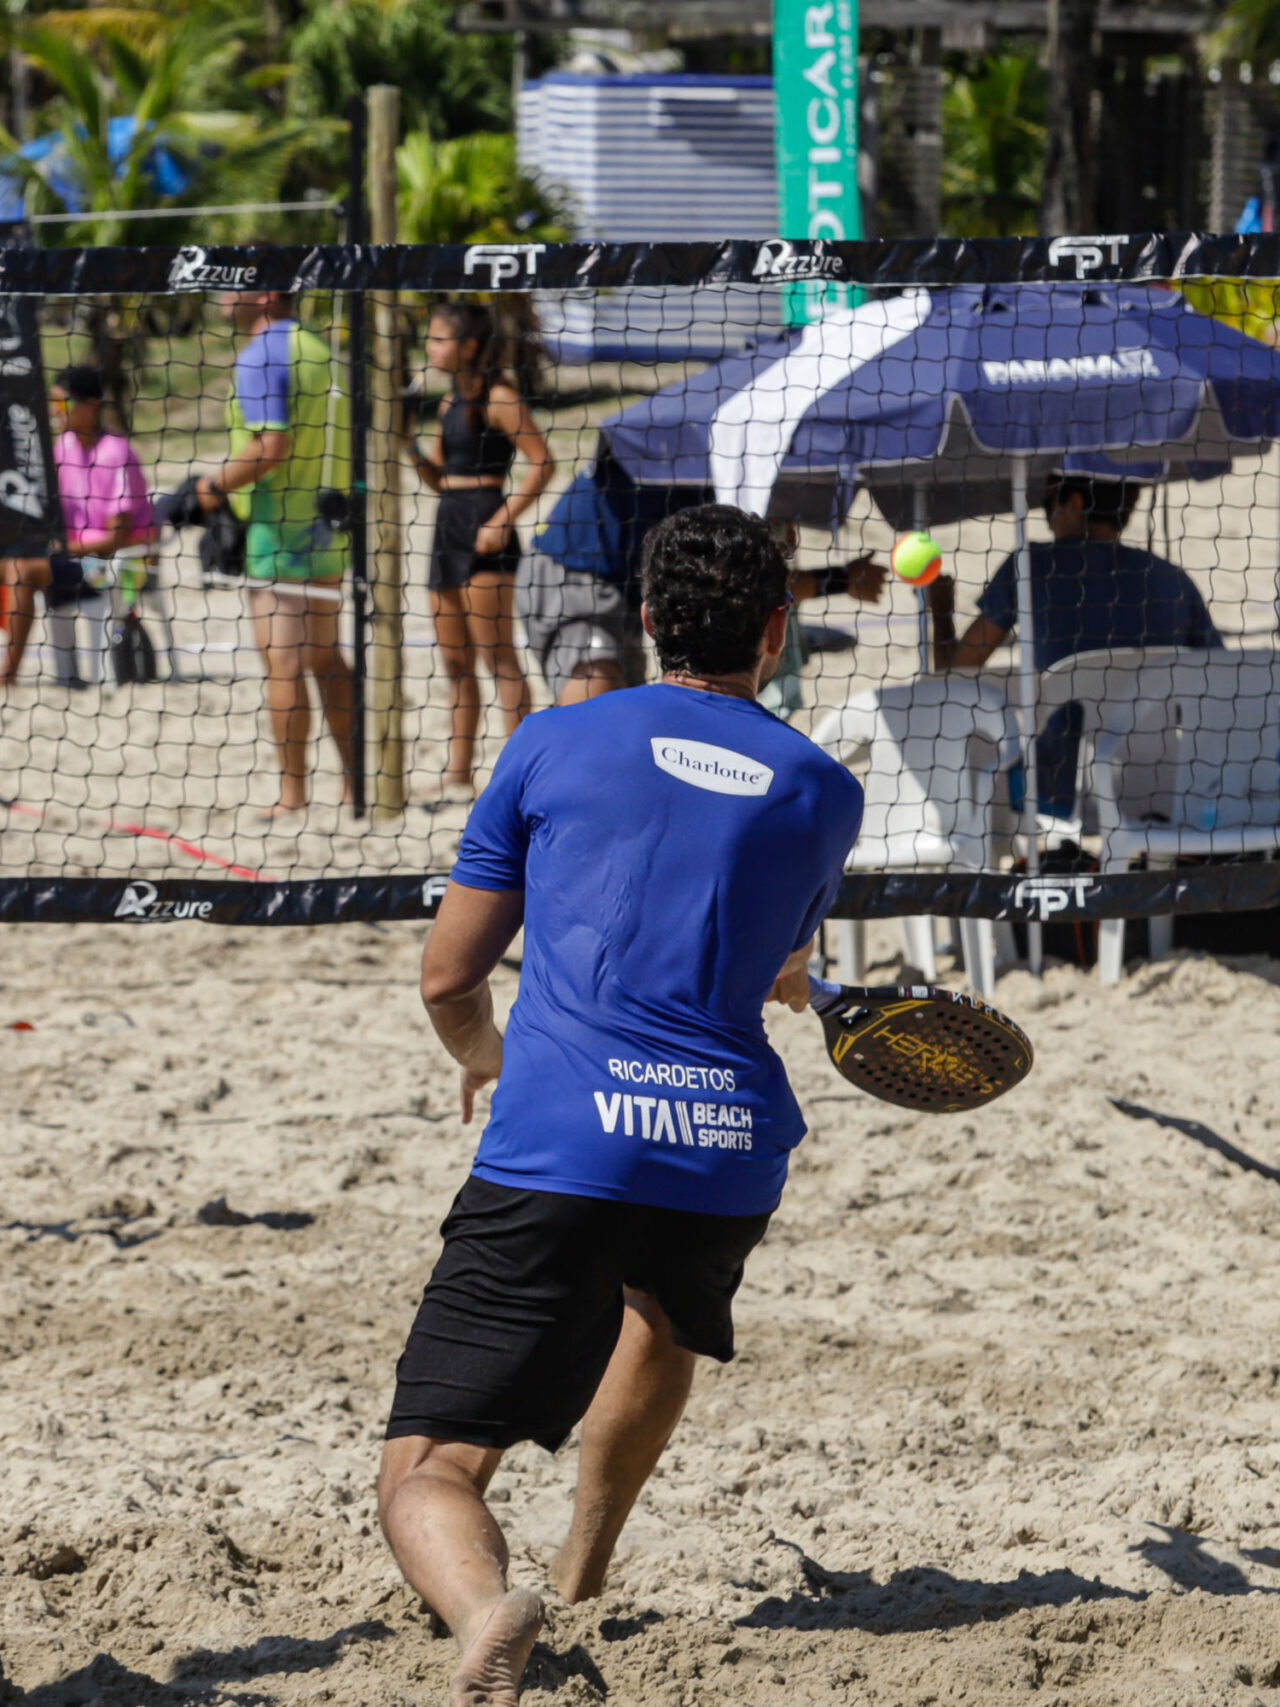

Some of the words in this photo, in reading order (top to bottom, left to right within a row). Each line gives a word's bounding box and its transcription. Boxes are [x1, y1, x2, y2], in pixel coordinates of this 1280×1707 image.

[464, 244, 546, 288] FPT
[1049, 235, 1130, 279] FPT
[661, 746, 762, 785] Charlotte
[1015, 878, 1094, 921] FPT
[608, 1058, 736, 1092] RICARDETOS
[593, 1091, 678, 1144] VITA
[692, 1102, 752, 1130] BEACH
[698, 1129, 753, 1151] SPORTS
